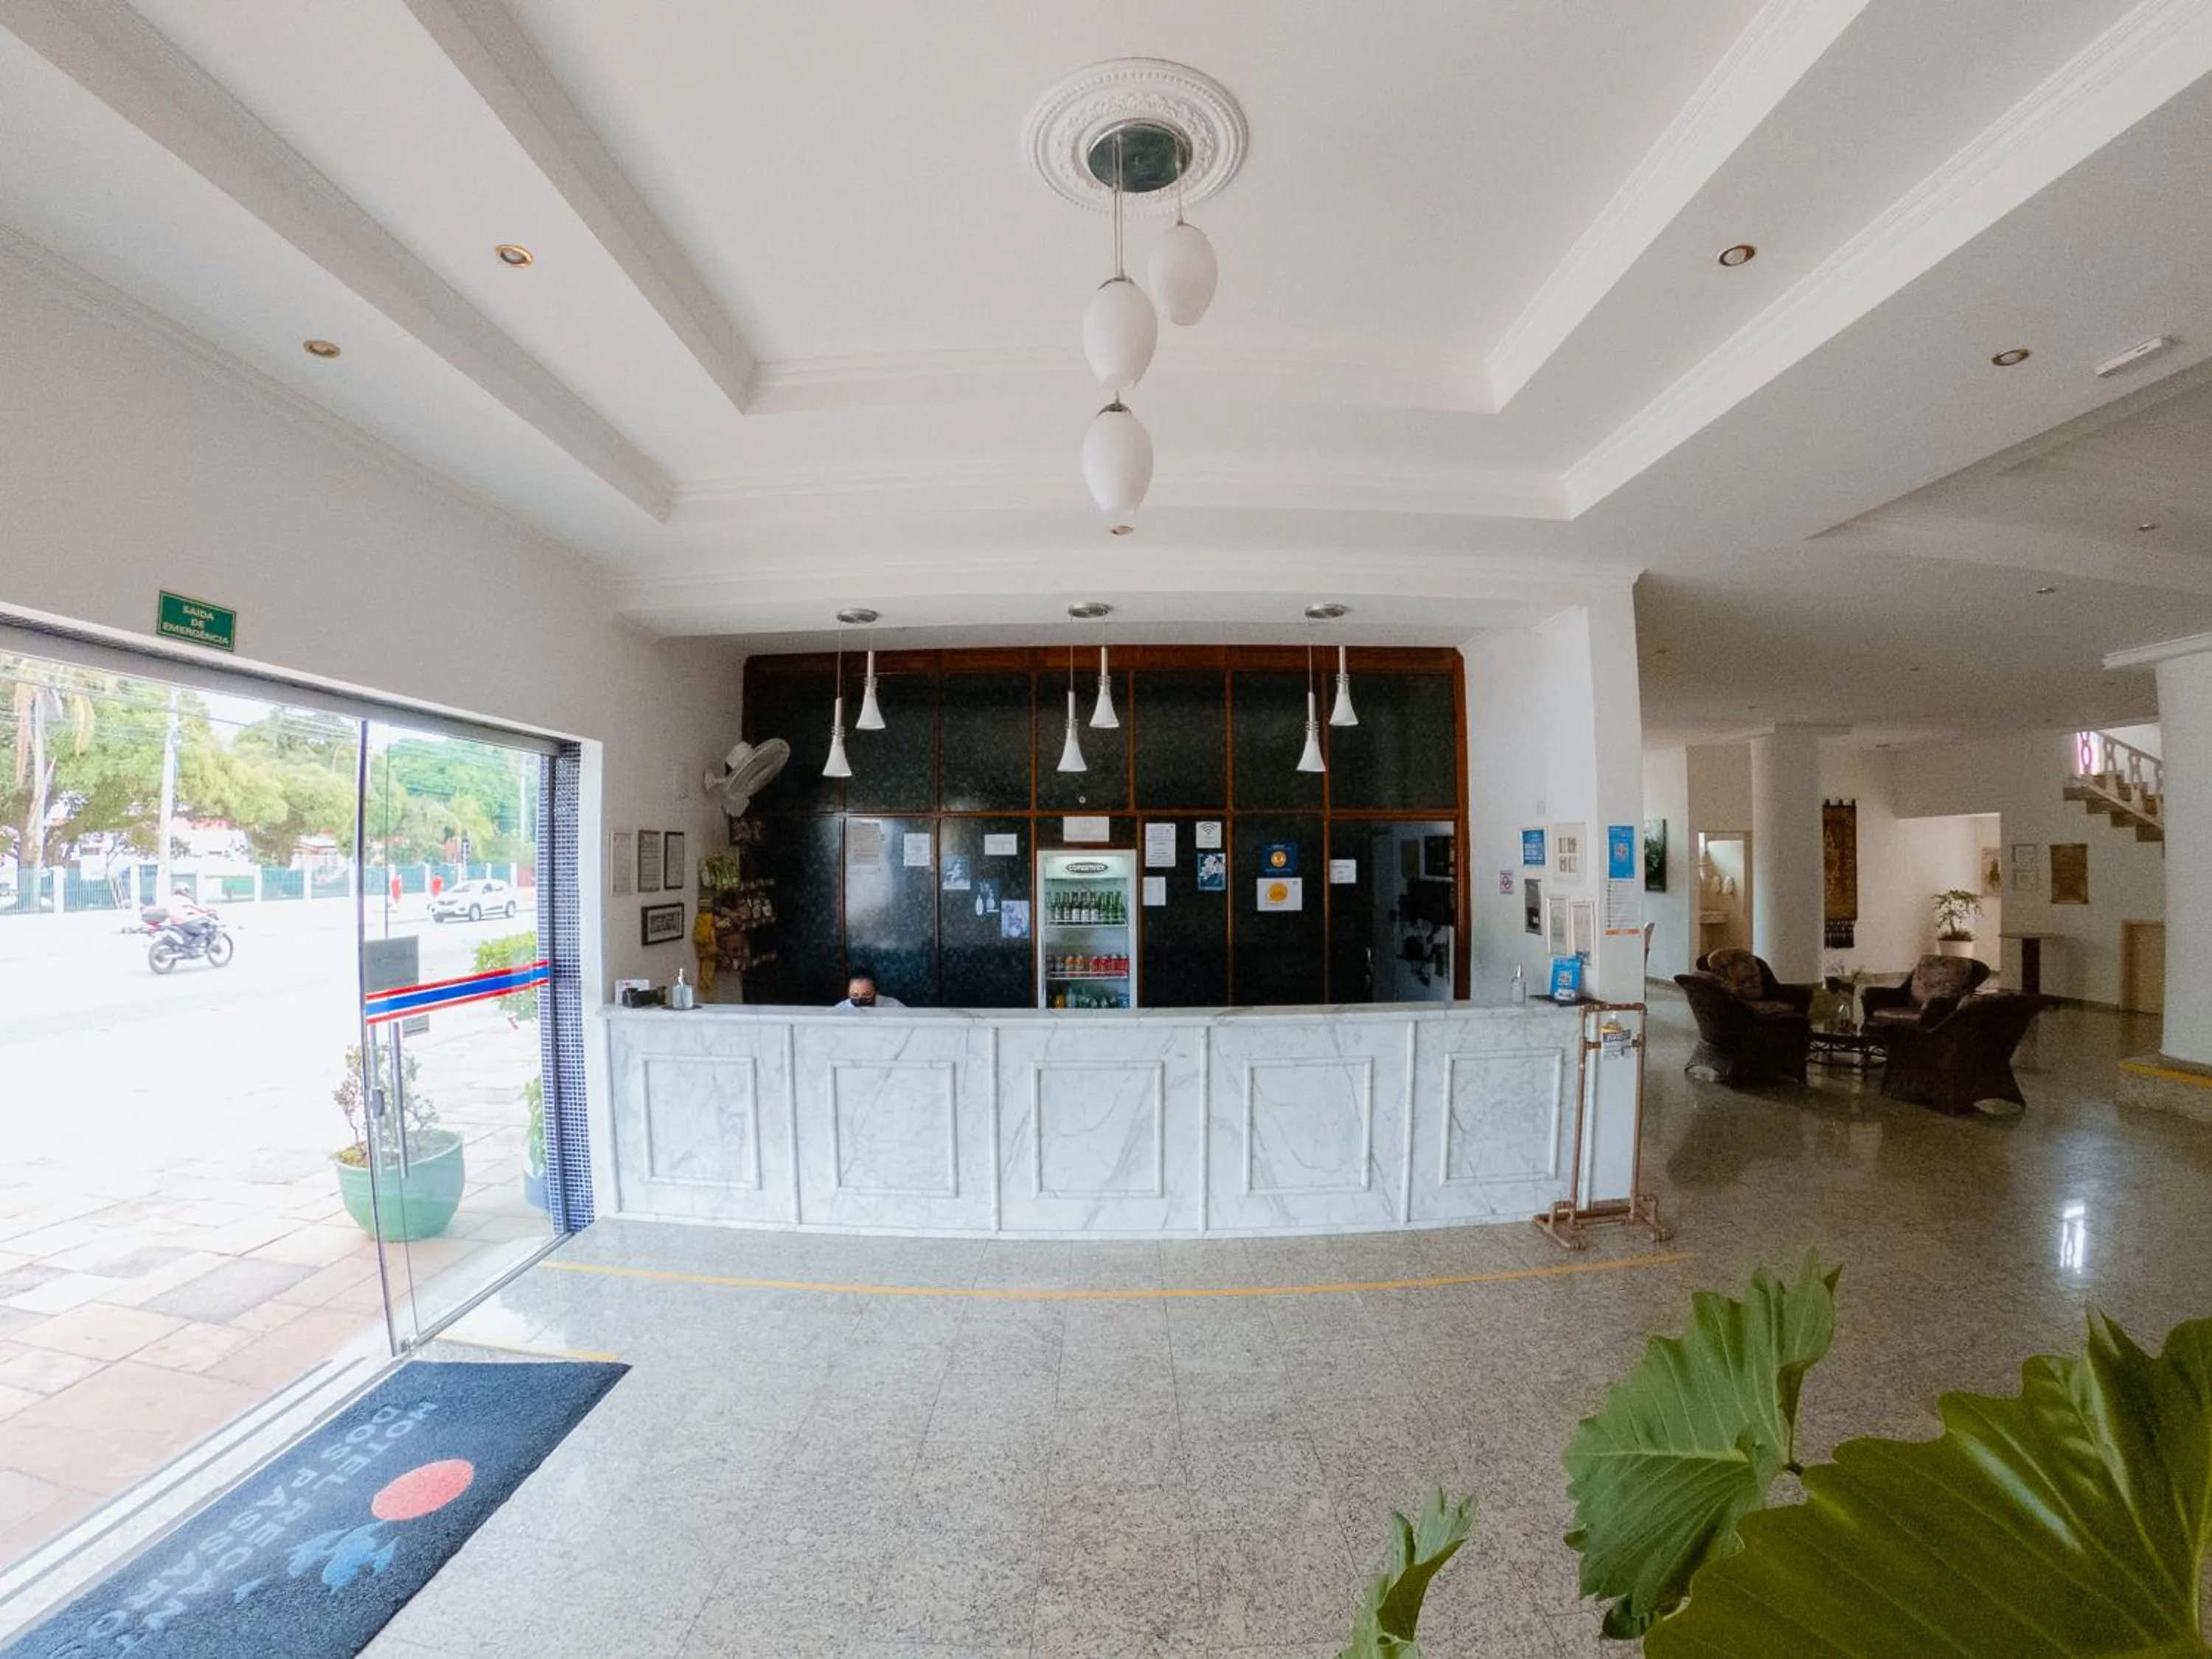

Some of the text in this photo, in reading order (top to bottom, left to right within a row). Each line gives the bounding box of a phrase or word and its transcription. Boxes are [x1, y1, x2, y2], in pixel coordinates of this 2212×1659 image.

[191, 618, 205, 630] DE
[313, 1401, 438, 1490] HOTEL
[320, 1405, 400, 1461] DOS
